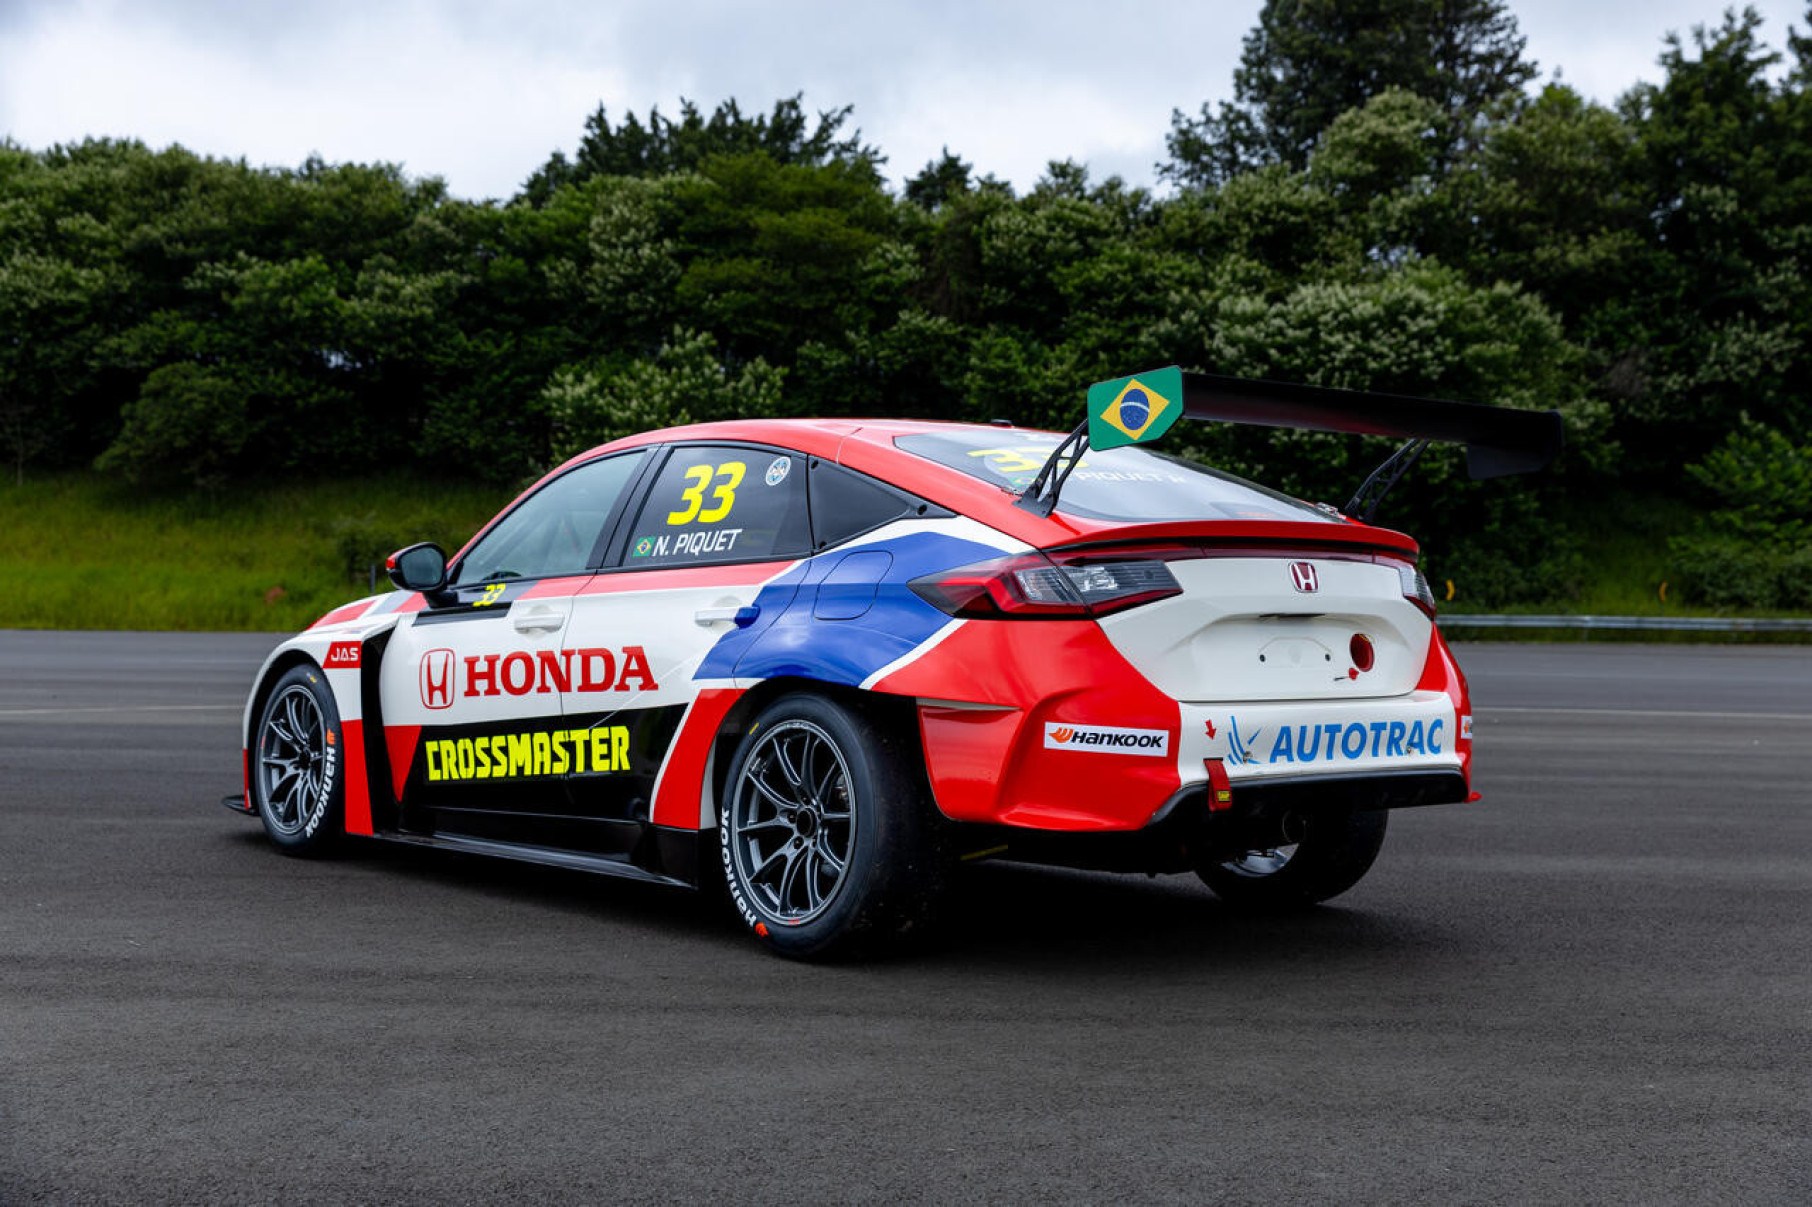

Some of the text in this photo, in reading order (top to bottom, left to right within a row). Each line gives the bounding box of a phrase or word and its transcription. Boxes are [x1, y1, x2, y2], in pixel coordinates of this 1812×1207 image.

[667, 461, 746, 526] 33
[652, 528, 743, 556] N. PIQUET
[473, 583, 506, 608] 33
[330, 647, 359, 662] JAS
[464, 646, 659, 697] HONDA
[426, 726, 631, 782] CROSSMASTER
[1269, 719, 1444, 763] AUTOTRAC
